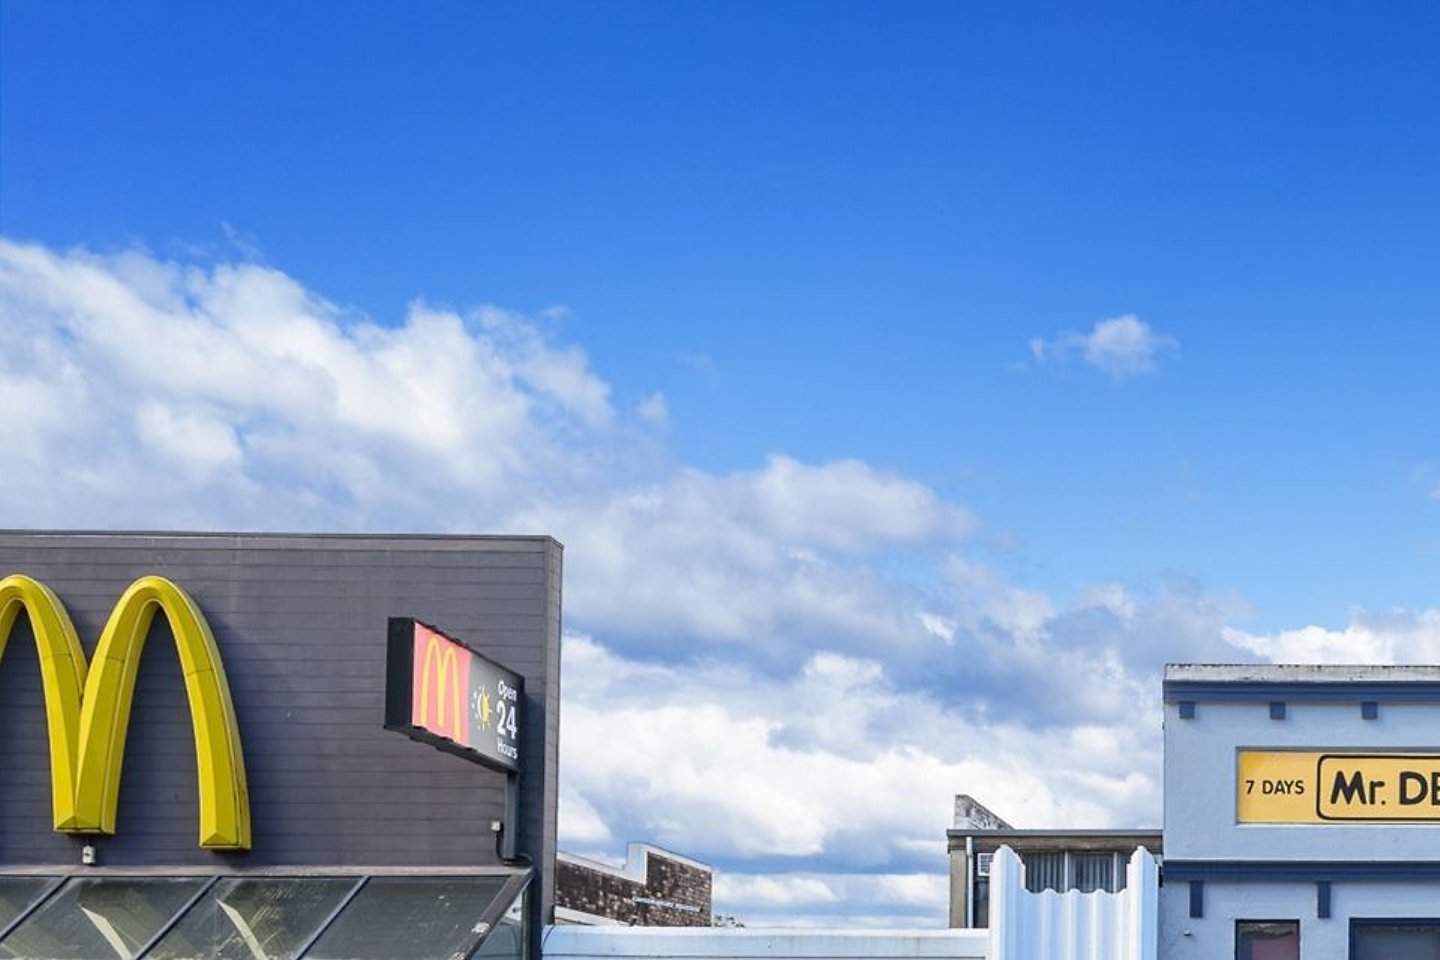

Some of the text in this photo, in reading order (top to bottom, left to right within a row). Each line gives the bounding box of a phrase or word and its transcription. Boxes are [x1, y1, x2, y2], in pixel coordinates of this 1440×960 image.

[497, 679, 517, 702] Open
[495, 699, 518, 740] 24
[497, 737, 518, 760] Hours
[1245, 780, 1305, 796] 7 DAYS
[1329, 770, 1386, 805] Mr.
